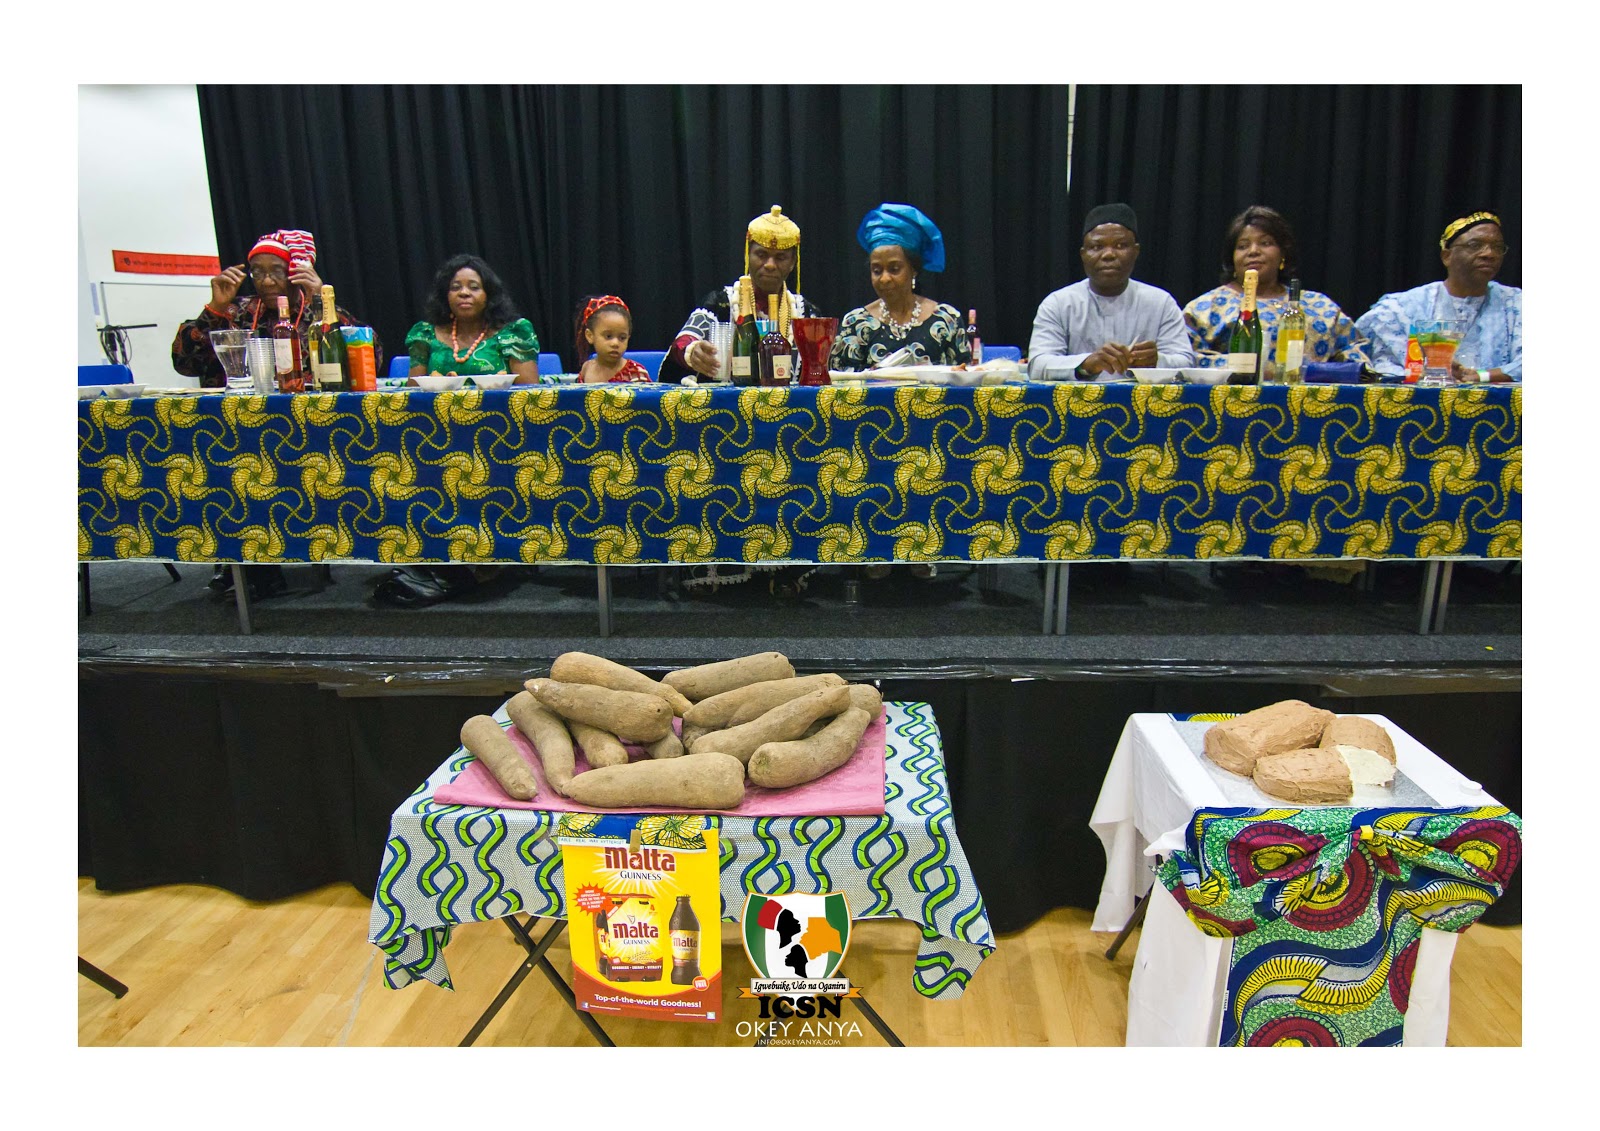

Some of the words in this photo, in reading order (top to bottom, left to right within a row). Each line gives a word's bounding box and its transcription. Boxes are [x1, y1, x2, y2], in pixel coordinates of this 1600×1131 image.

[620, 870, 662, 881] GUINNESS
[594, 994, 659, 1006] Top-of-the-world
[661, 998, 702, 1008] Goodness!
